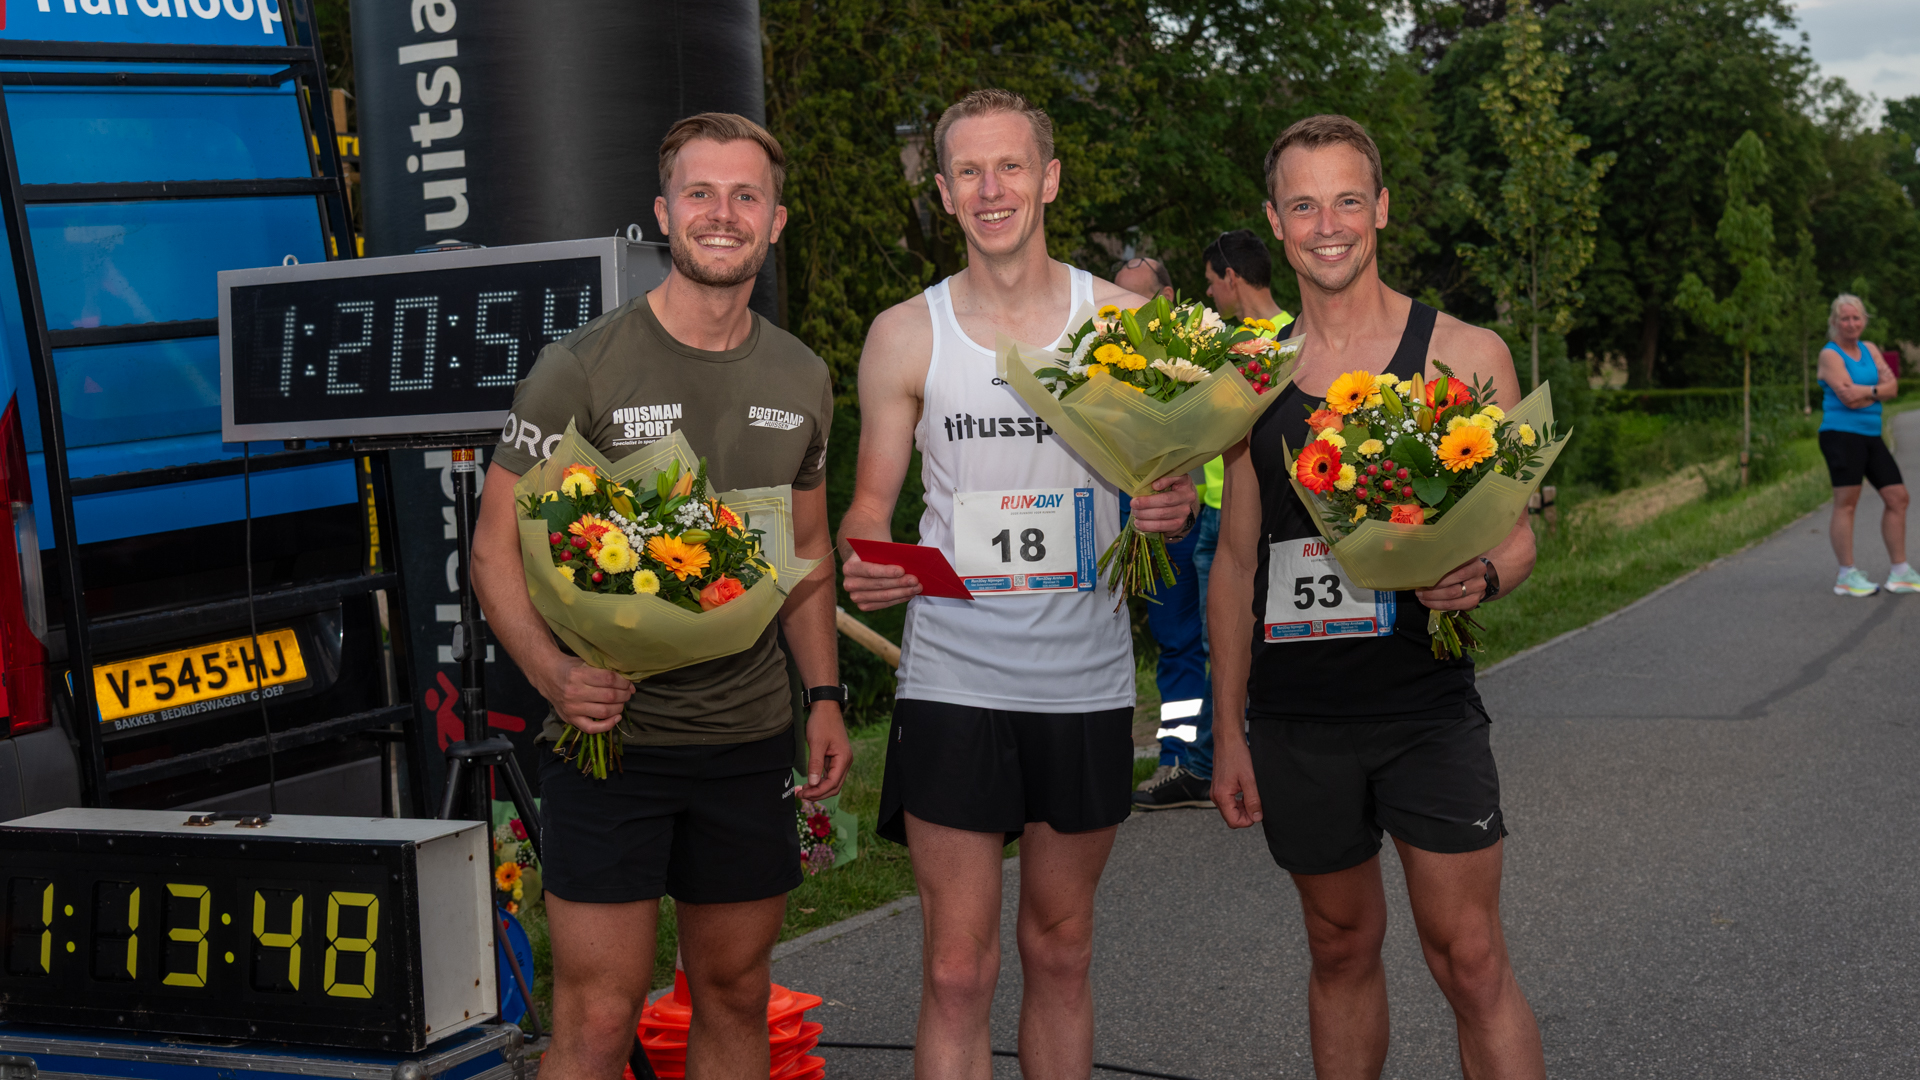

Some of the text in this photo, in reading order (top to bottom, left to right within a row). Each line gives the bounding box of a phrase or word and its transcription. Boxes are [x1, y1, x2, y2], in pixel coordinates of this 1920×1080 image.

[612, 403, 683, 425] HUISMAN
[624, 420, 673, 438] SPORT
[944, 413, 1058, 444] titussp
[612, 440, 637, 448] Specialist
[991, 527, 1047, 563] 18
[1293, 574, 1343, 610] 53
[106, 640, 287, 709] V-545-HJ
[114, 713, 157, 731] BAKKER
[160, 694, 246, 721] BEDRIJFSWAGEN
[40, 882, 380, 999] 1:13:48
